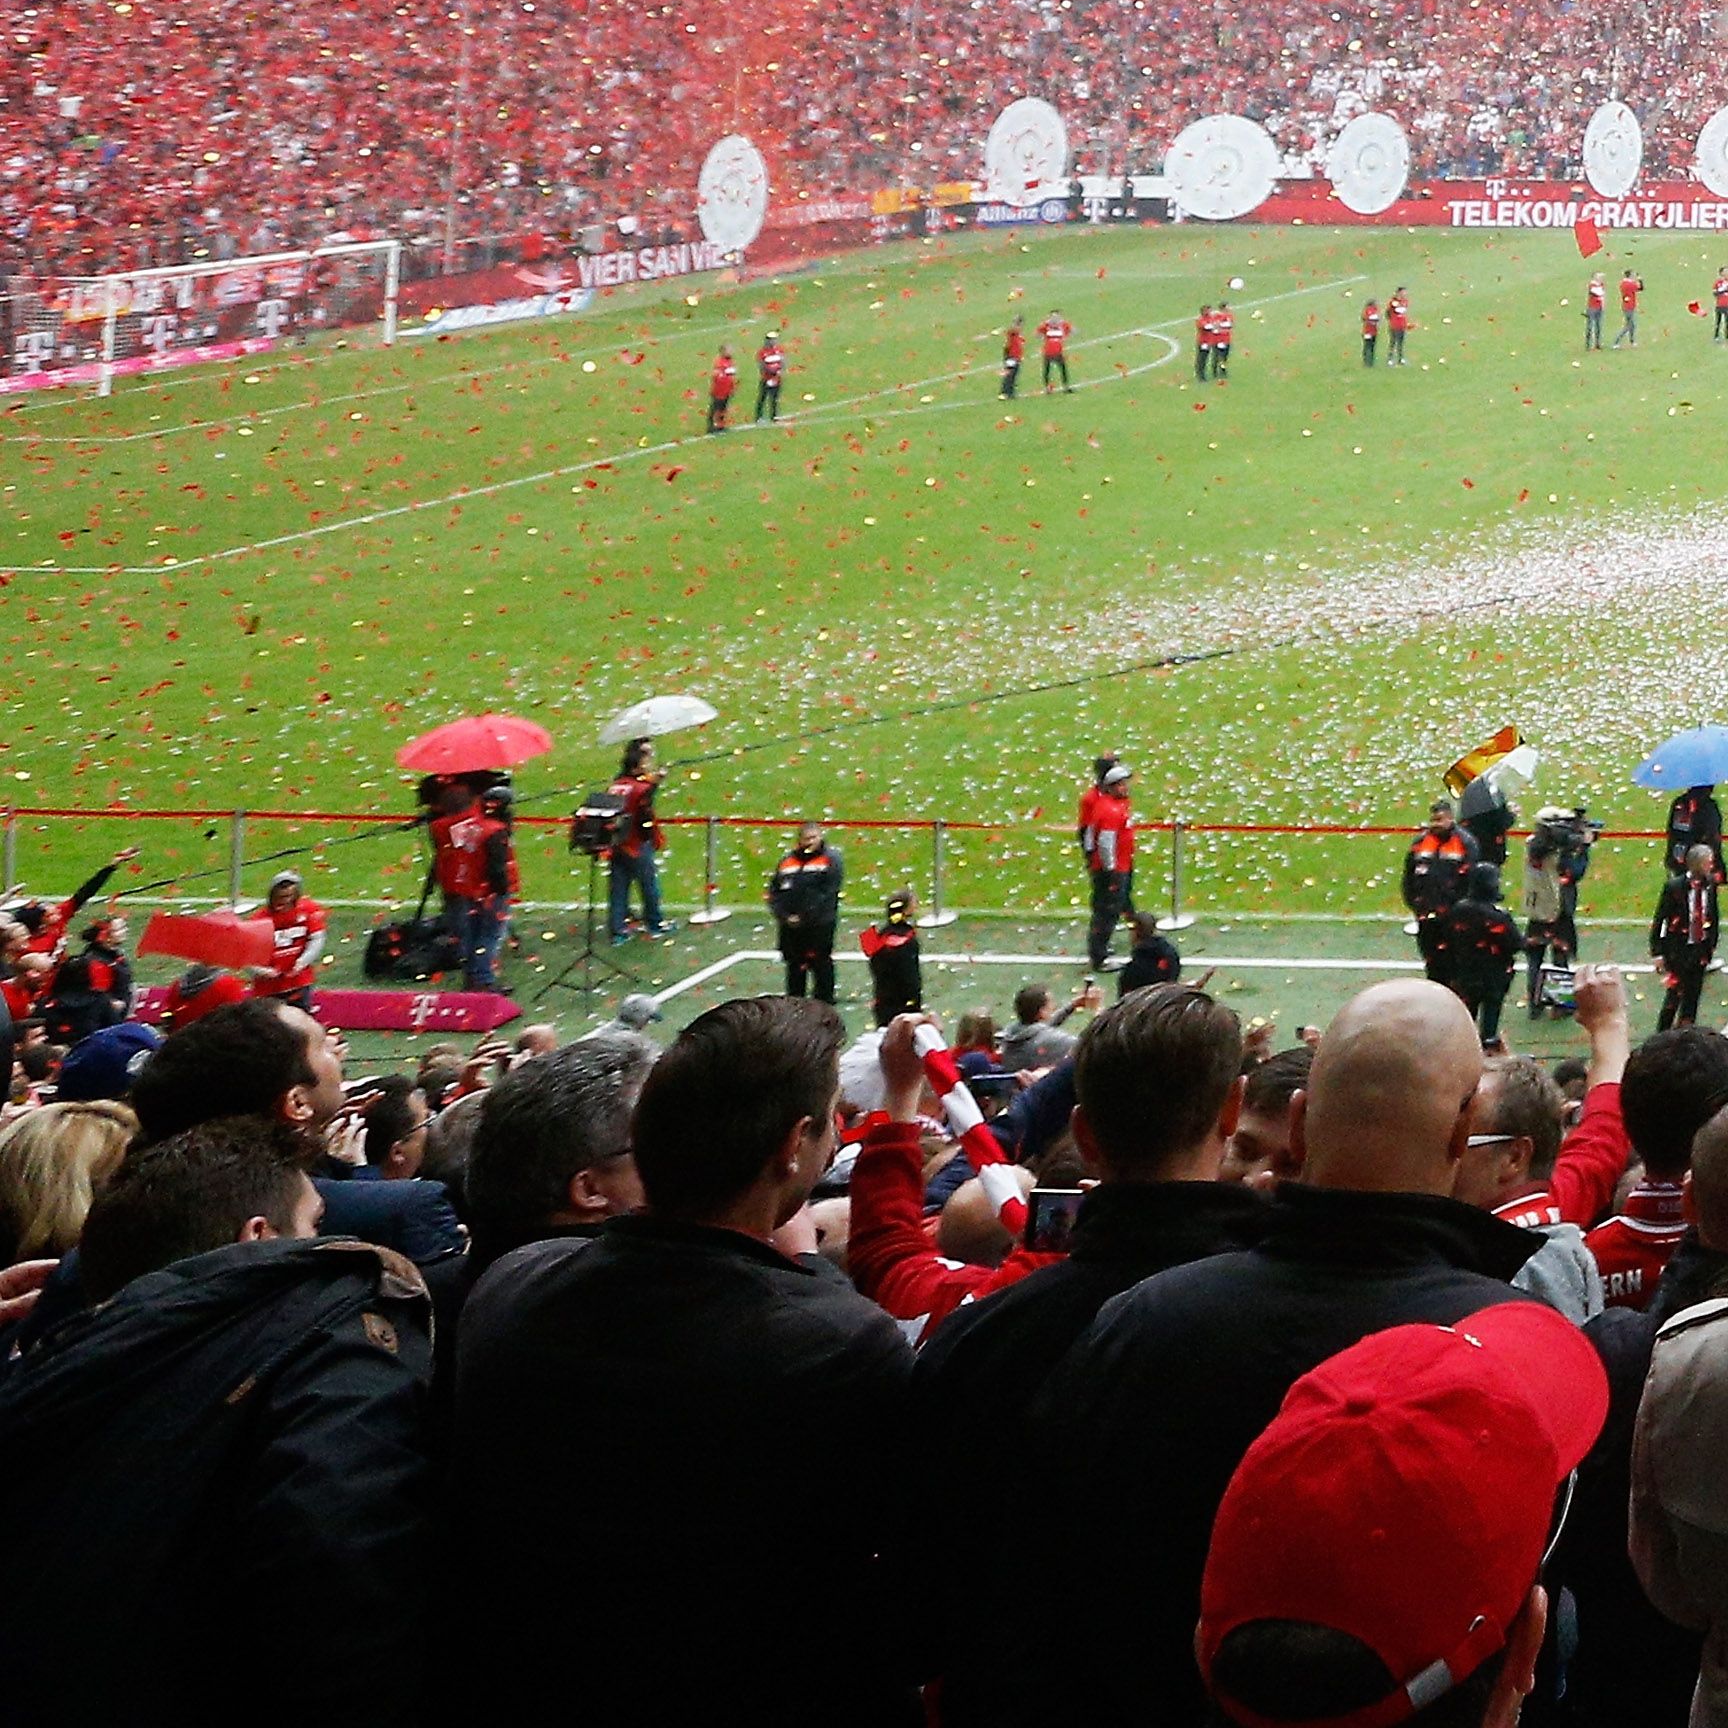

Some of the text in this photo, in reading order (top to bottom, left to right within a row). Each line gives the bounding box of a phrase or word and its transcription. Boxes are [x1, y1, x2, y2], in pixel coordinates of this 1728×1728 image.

[1448, 200, 1577, 227] TELEKOM
[578, 251, 637, 289] VIER
[637, 245, 690, 282] SAN
